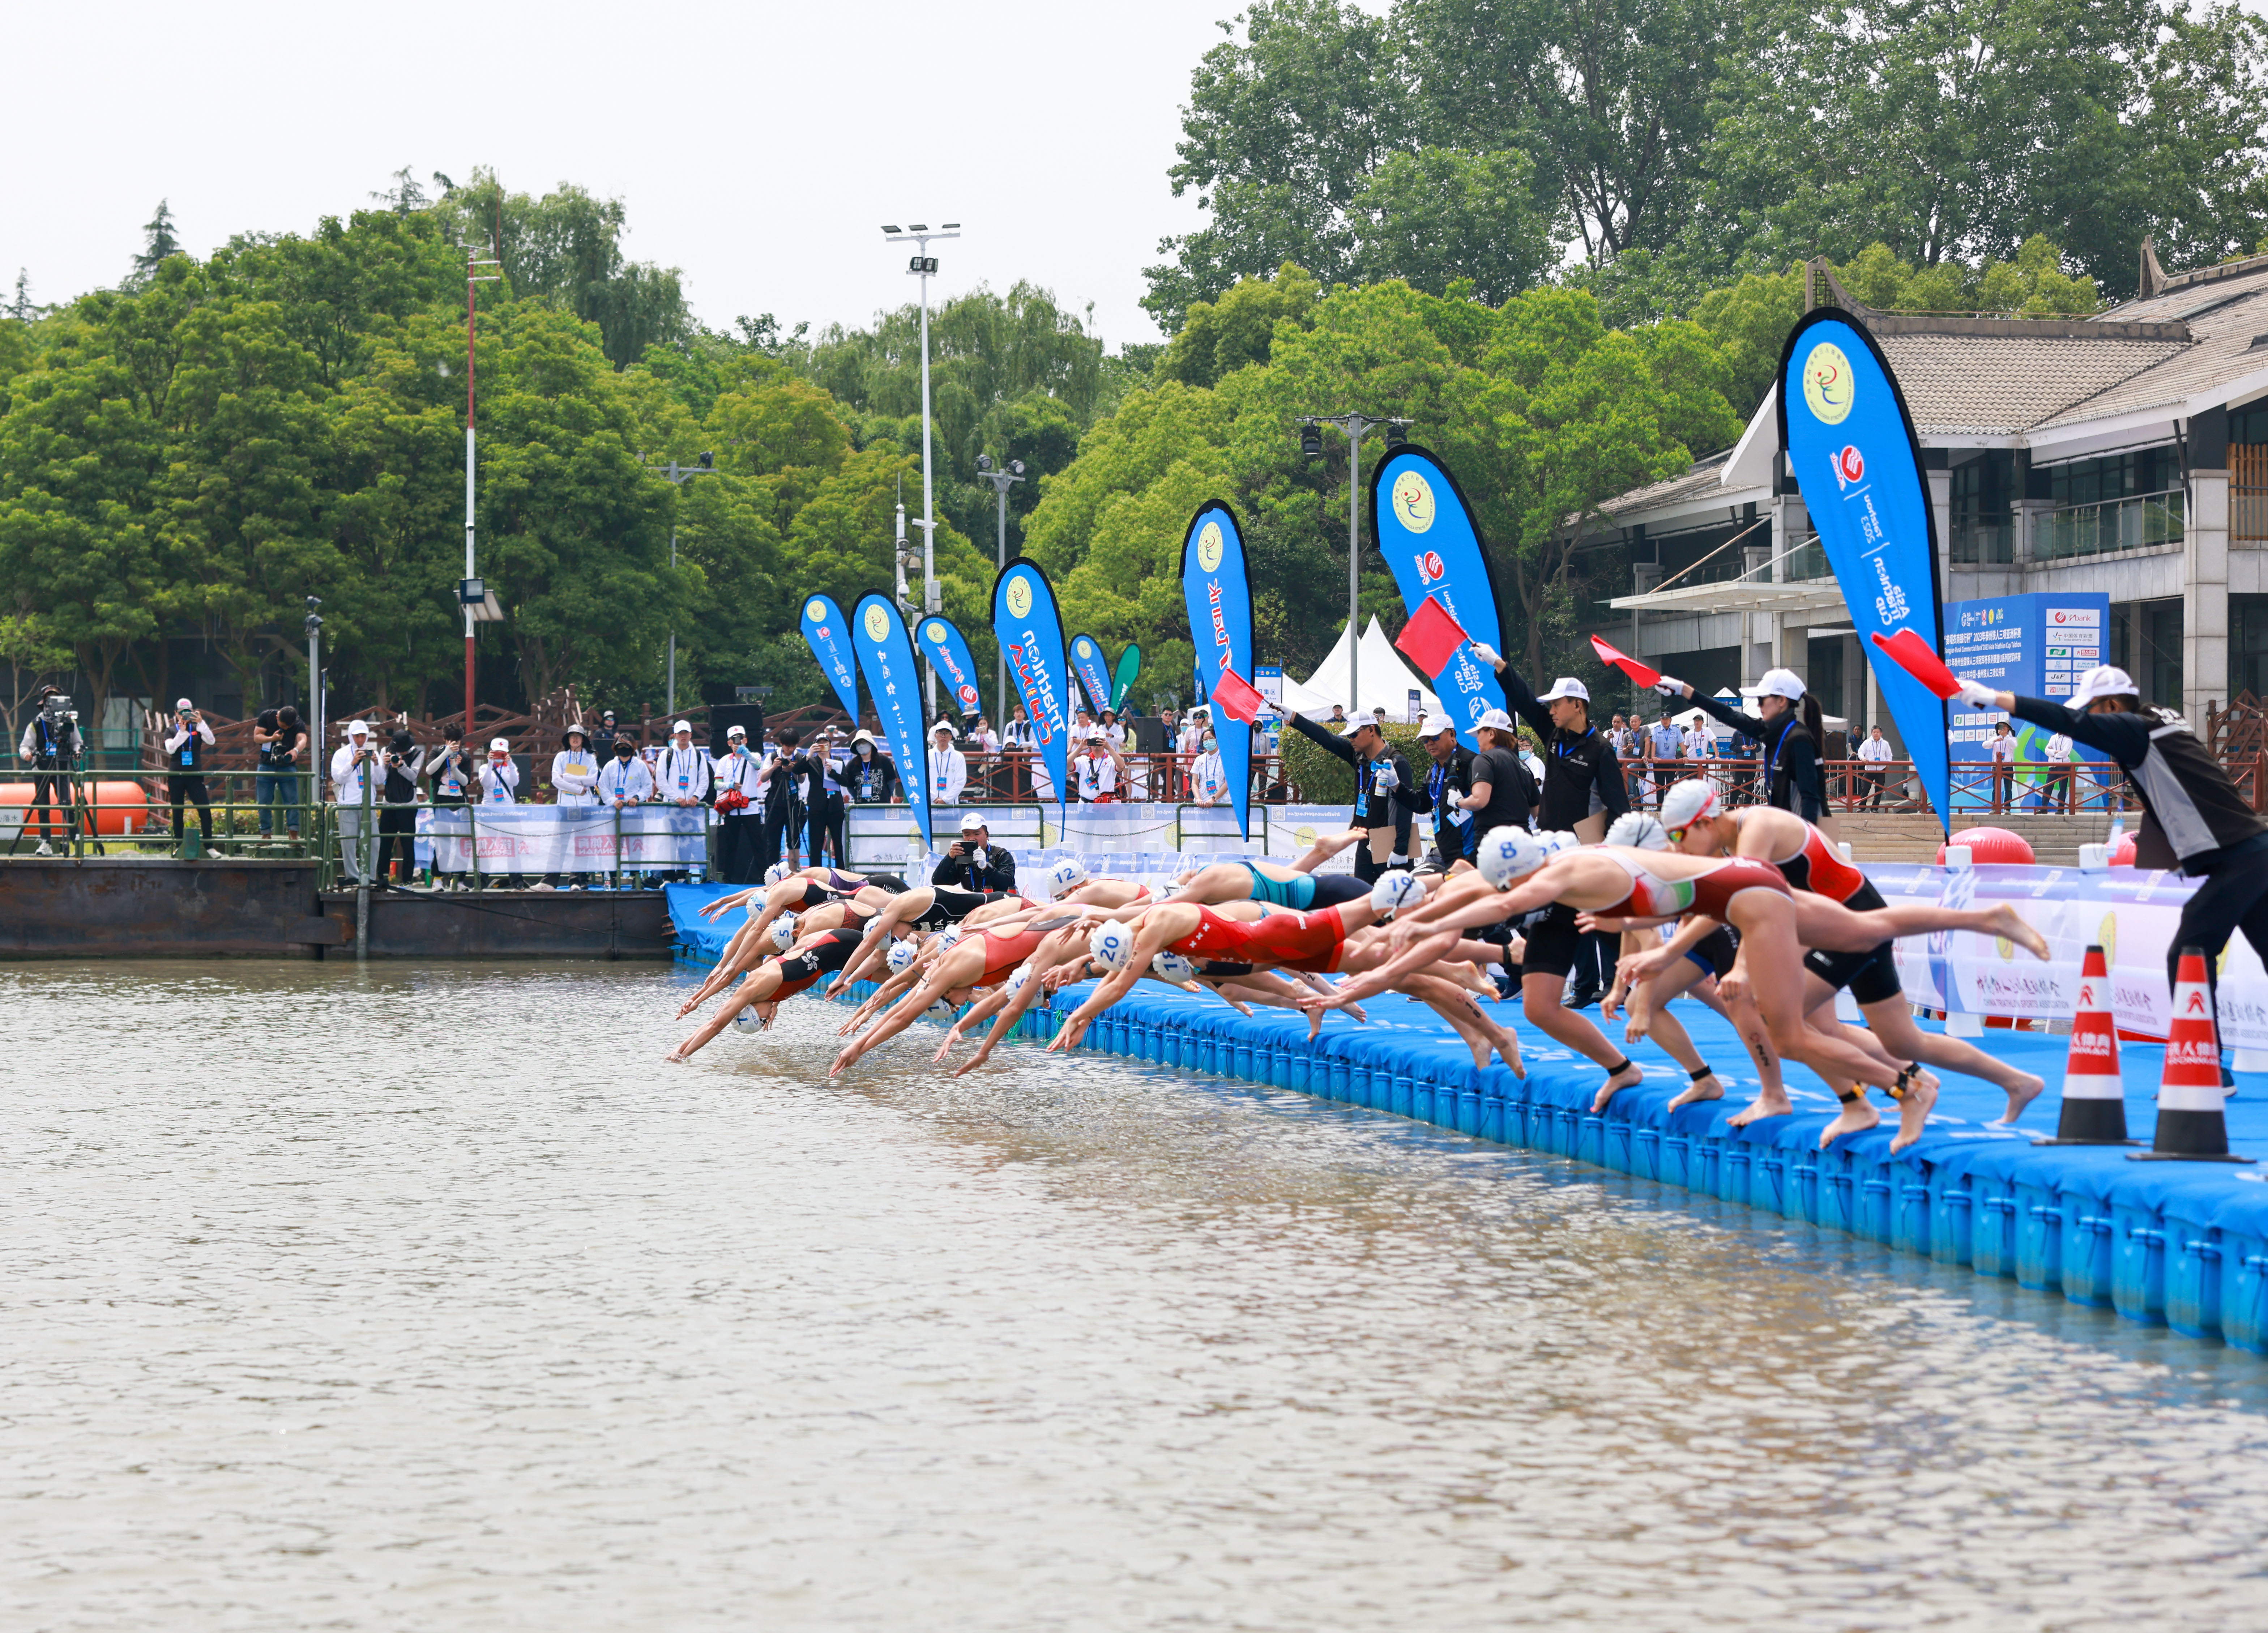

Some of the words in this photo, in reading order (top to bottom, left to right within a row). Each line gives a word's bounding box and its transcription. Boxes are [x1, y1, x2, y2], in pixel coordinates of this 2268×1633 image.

[1500, 842, 1517, 859] 8
[1054, 867, 1076, 884] 12
[1388, 877, 1412, 892] 19
[755, 903, 763, 912] 4
[779, 929, 789, 938] 5
[893, 949, 906, 966] 10
[1100, 936, 1119, 963] 20
[1162, 950, 1178, 972] 18
[1300, 971, 1315, 982] 12
[1756, 1044, 1770, 1067] 22
